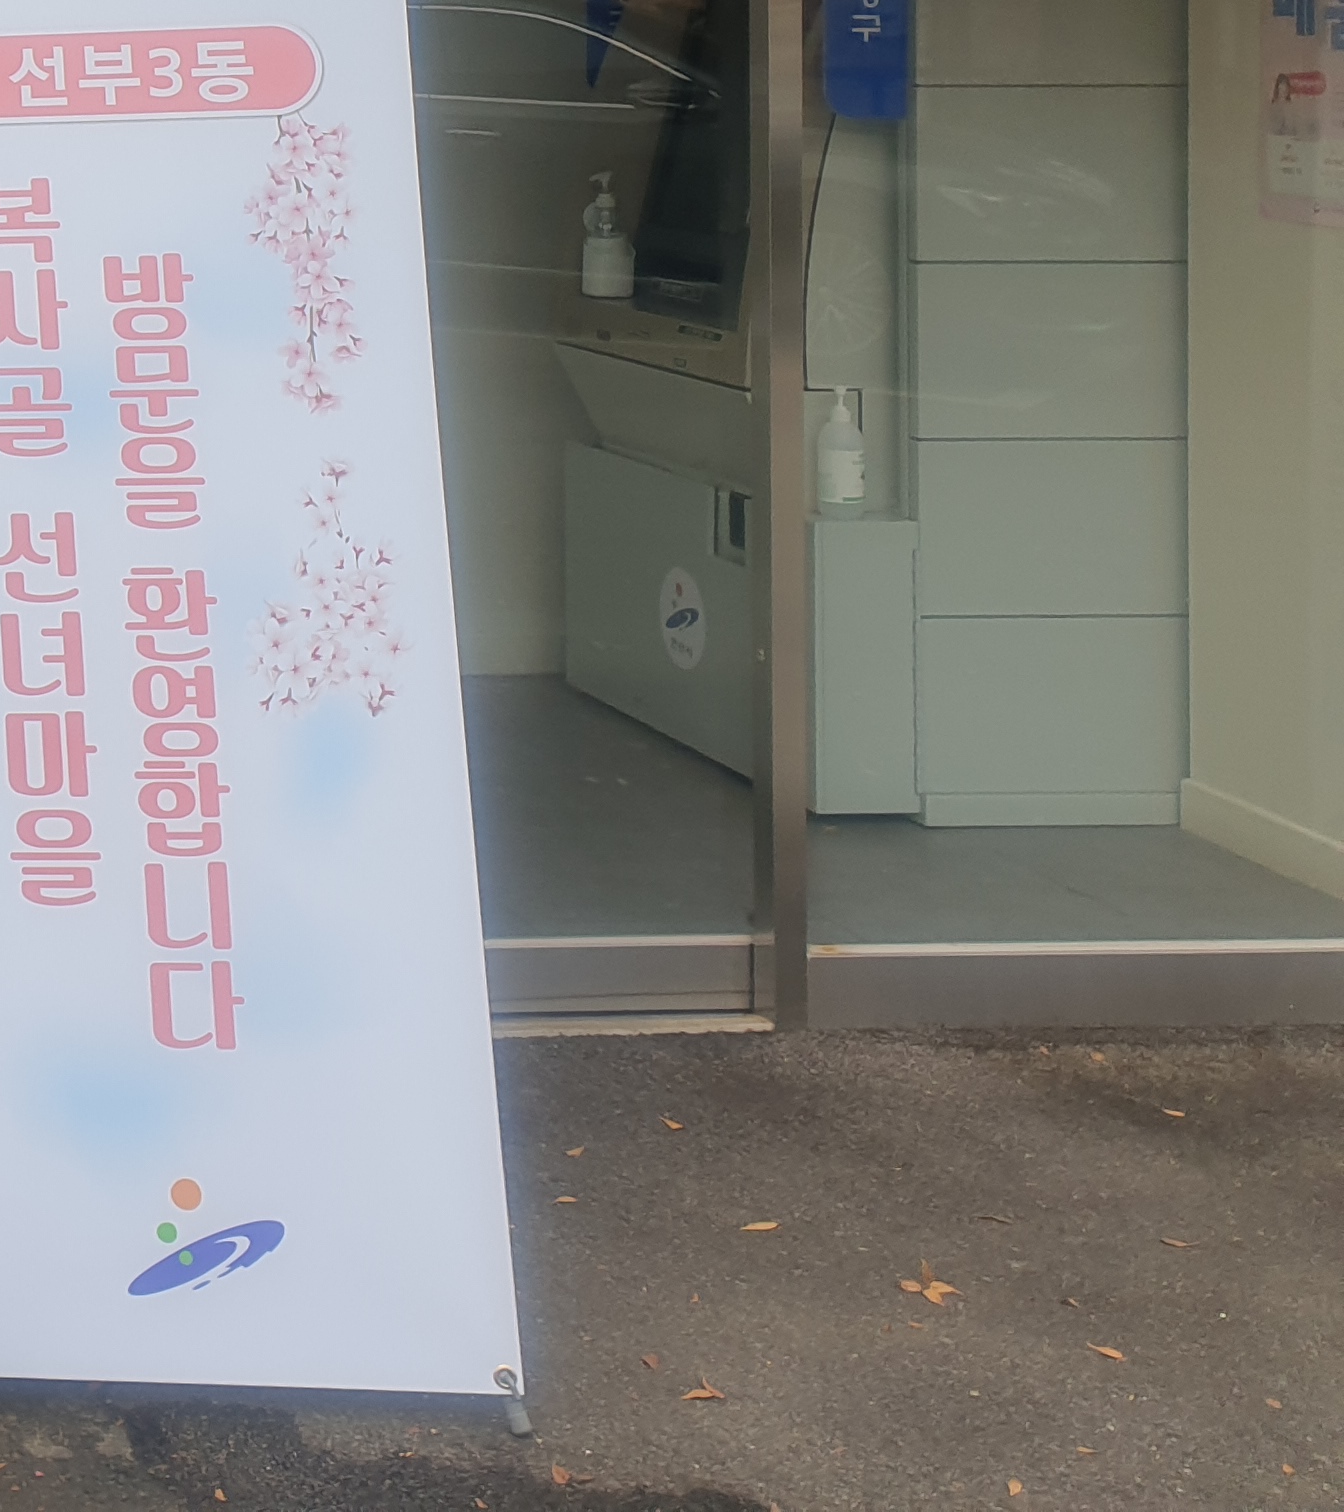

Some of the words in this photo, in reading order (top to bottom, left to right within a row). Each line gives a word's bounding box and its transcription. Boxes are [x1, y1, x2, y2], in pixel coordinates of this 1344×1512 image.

[8, 39, 255, 108] 선부3동
[102, 251, 210, 533] 방문을
[121, 563, 246, 1052] 환영합니다
